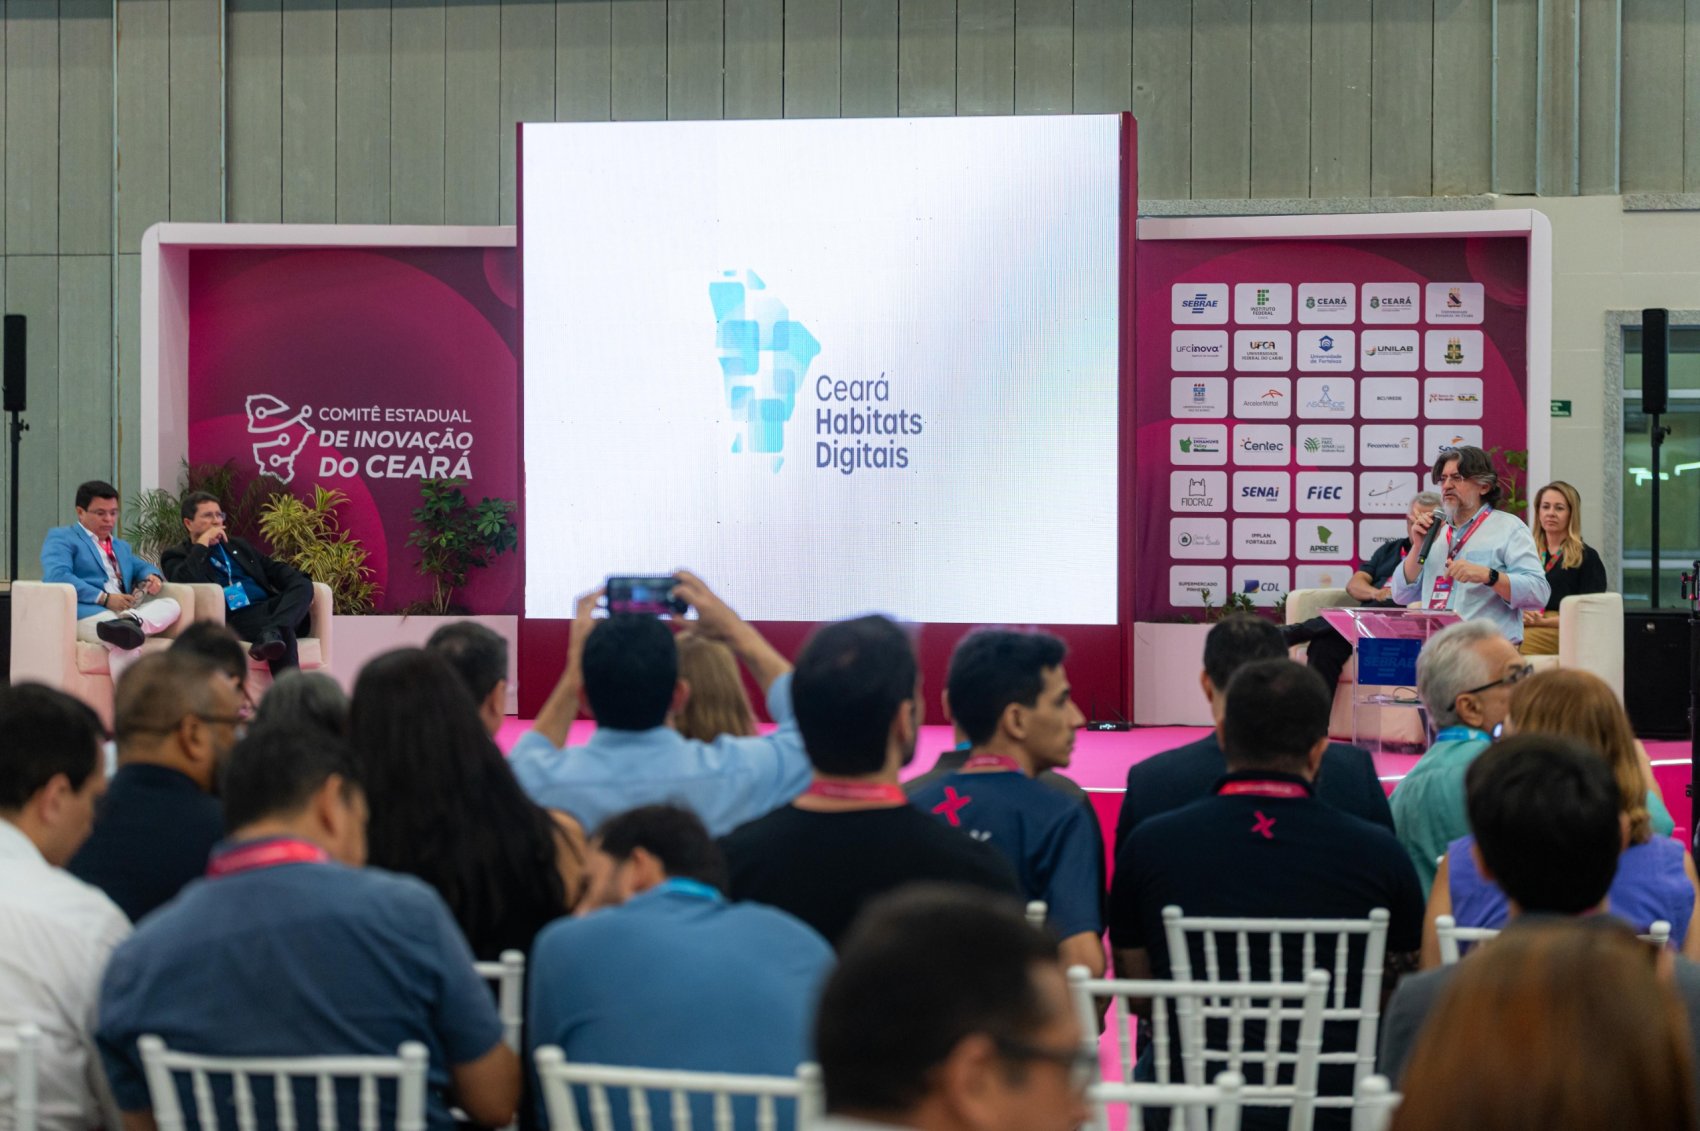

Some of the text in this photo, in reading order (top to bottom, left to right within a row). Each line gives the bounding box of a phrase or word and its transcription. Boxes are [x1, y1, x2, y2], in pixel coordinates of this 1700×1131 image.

[1182, 300, 1218, 308] SEBRAE
[1317, 297, 1347, 305] CEARÁ
[1381, 296, 1412, 305] CEARÁ
[816, 371, 889, 402] Ceará
[319, 404, 472, 423] COMITÊ ESTADUAL
[816, 406, 923, 435] Habitats
[319, 428, 474, 454] DE INOVAÇÃO
[1243, 441, 1284, 451] Centec
[816, 439, 909, 475] Digitais
[318, 450, 473, 480] DO CEARÁ
[1181, 498, 1213, 507] FIOCRUZ
[1260, 582, 1280, 591] CDL
[1363, 656, 1415, 668] SEBRAE
